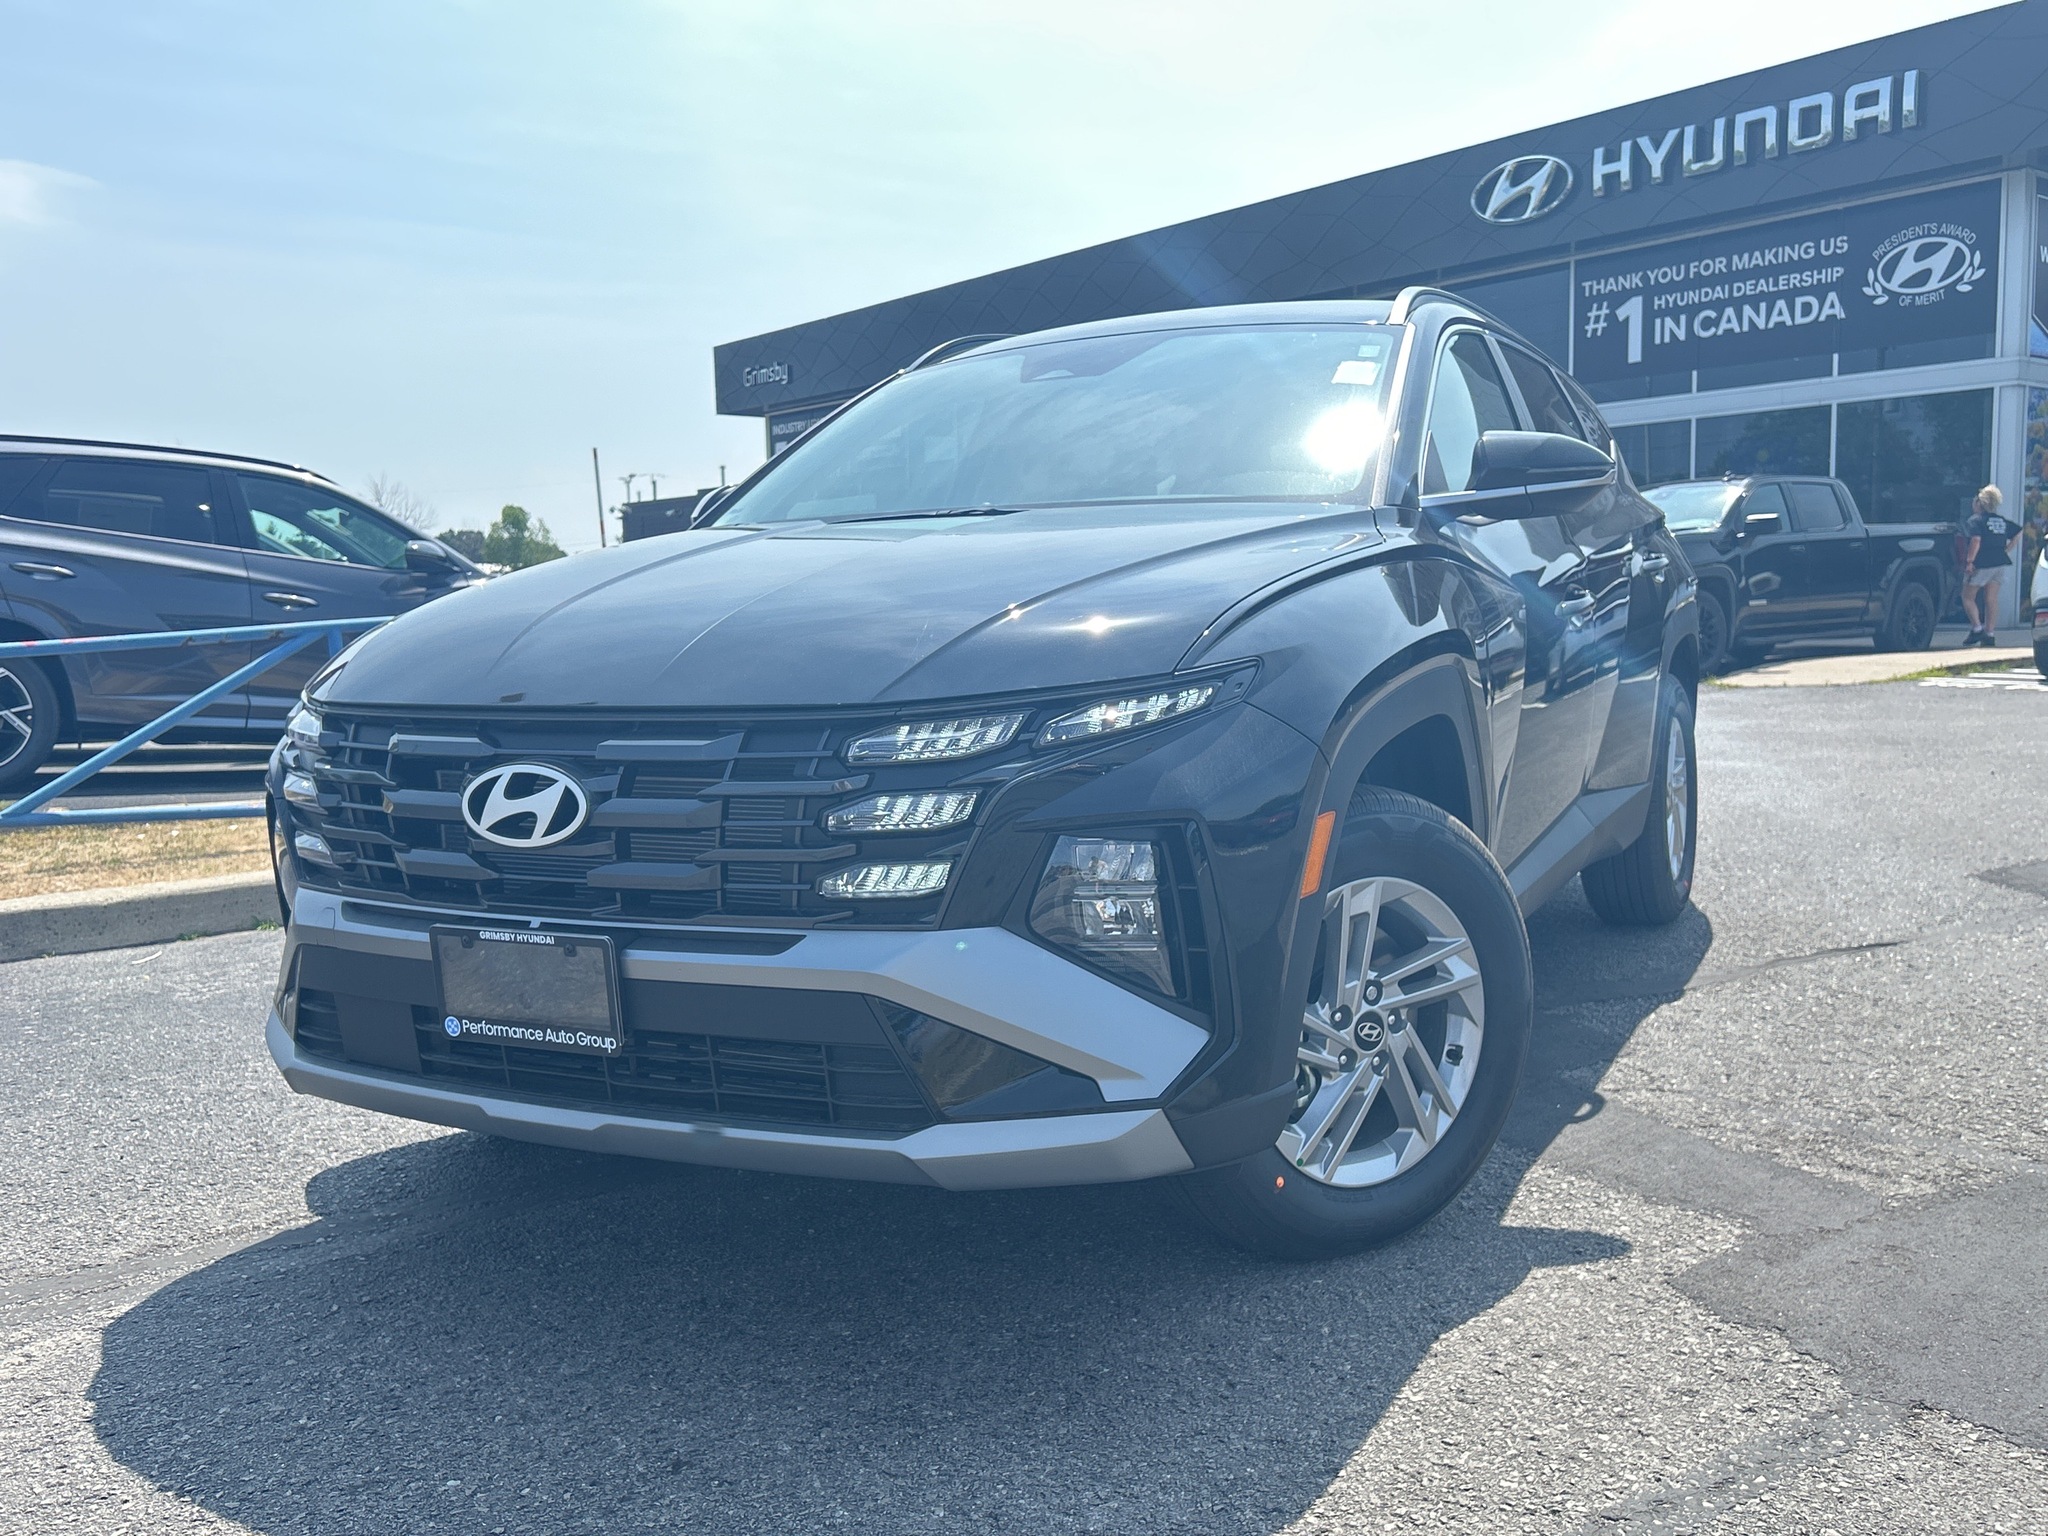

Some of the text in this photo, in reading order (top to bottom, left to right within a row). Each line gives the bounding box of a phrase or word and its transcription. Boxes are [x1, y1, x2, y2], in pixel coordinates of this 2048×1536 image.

[1592, 69, 1919, 197] HYUNDAI
[1872, 223, 1977, 261] PRESIDENT'S AWARD
[1581, 235, 1849, 297] THANK YOU FOR MAKING US
[1653, 266, 1844, 310] HYUNDAI DEALERSHIP
[1898, 289, 1945, 307] OF MERIT
[1653, 291, 1846, 345] IN CANADA
[743, 361, 788, 387] Grimsby
[479, 930, 555, 945] GRIMSBY HYUNDAI
[462, 1019, 617, 1053] Performance Auto Group
